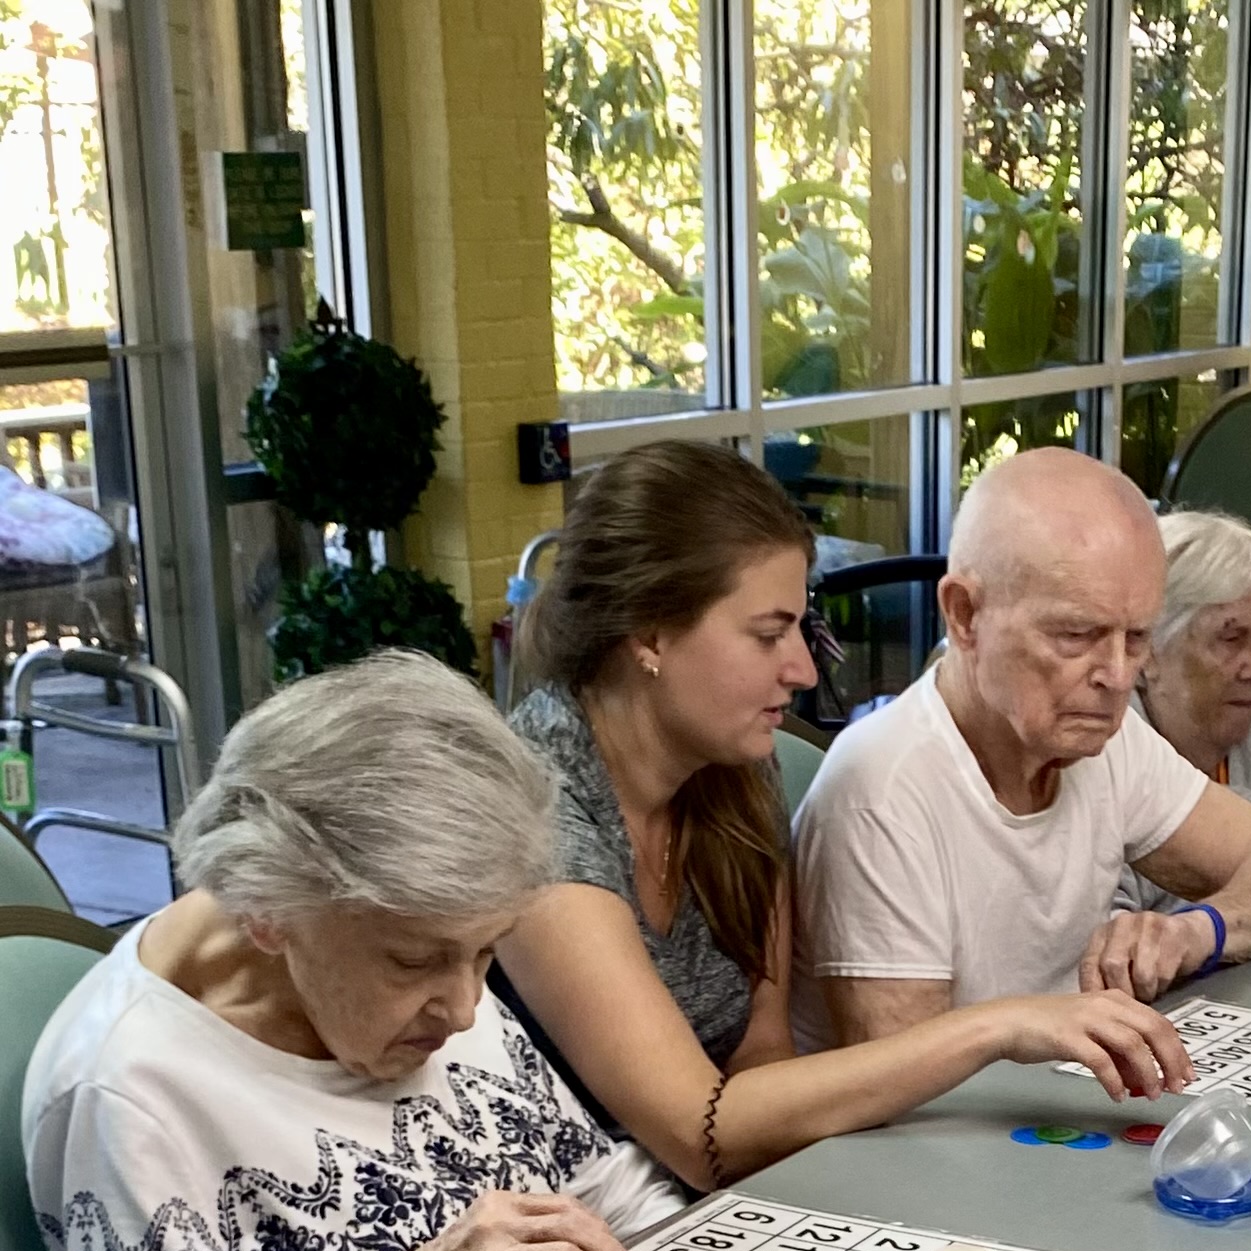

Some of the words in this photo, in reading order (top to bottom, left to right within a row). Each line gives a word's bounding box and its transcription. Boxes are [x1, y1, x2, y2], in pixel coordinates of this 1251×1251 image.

[1204, 1011, 1240, 1021] 5
[1207, 1045, 1251, 1061] 40
[733, 1211, 776, 1224] 6
[690, 1229, 746, 1249] 18
[796, 1223, 852, 1242] 12
[875, 1238, 920, 1251] 2
